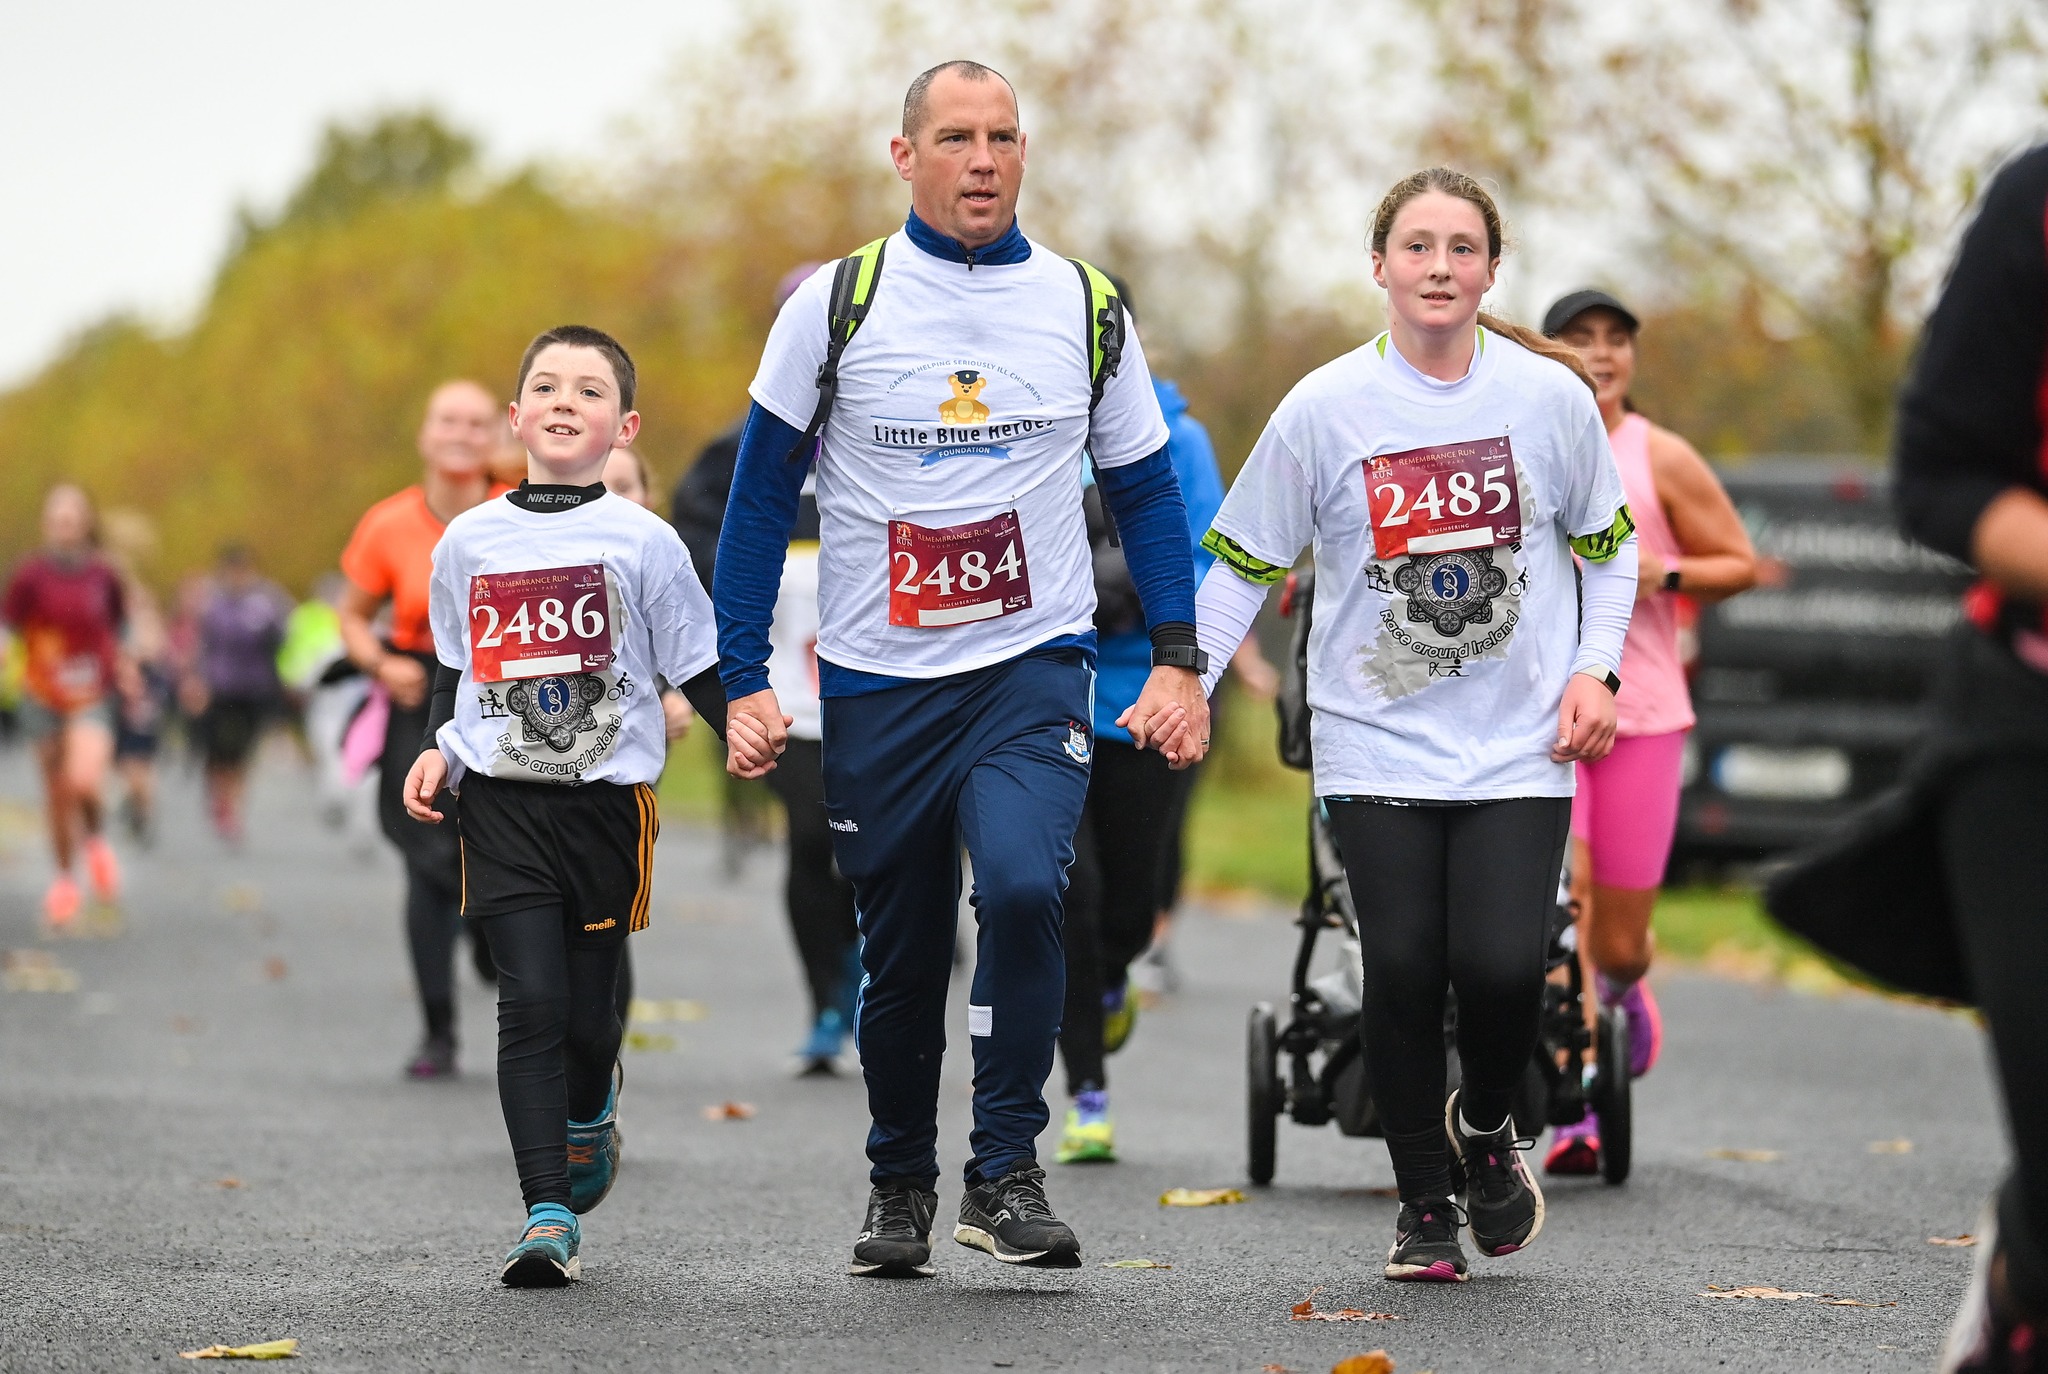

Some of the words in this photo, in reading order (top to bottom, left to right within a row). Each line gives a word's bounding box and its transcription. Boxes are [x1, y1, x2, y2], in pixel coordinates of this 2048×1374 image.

[916, 360, 951, 372] HELPING
[953, 359, 996, 370] SERIOUSLY
[997, 366, 1008, 376] ILL
[1009, 372, 1042, 402] CHILDREN
[873, 424, 928, 445] Little
[936, 427, 980, 444] Blue
[938, 447, 991, 458] FOUNDATION
[1398, 451, 1457, 466] REMEMBRANCE
[1457, 448, 1475, 457] RUN
[1371, 468, 1392, 479] RUN
[527, 493, 554, 503] NIKE
[555, 494, 581, 504] PRO
[1373, 464, 1511, 528] 2485
[917, 531, 973, 543] REMEMBRANCE
[974, 527, 990, 537] RUN
[1427, 523, 1470, 534] REMEMBERING
[896, 536, 912, 547] RUN
[893, 539, 1022, 597] 2484
[496, 576, 551, 588] REMEMBRANCE
[552, 575, 569, 583] RUN
[938, 598, 981, 608] REMEMBERING
[471, 593, 605, 649] 2486
[1379, 608, 1412, 646] Race
[1411, 643, 1470, 660] around
[1472, 609, 1519, 655] Ireland
[520, 650, 559, 658] REMEMBERING
[496, 732, 530, 767] Race
[530, 755, 588, 775] around
[585, 713, 622, 764] Ireland
